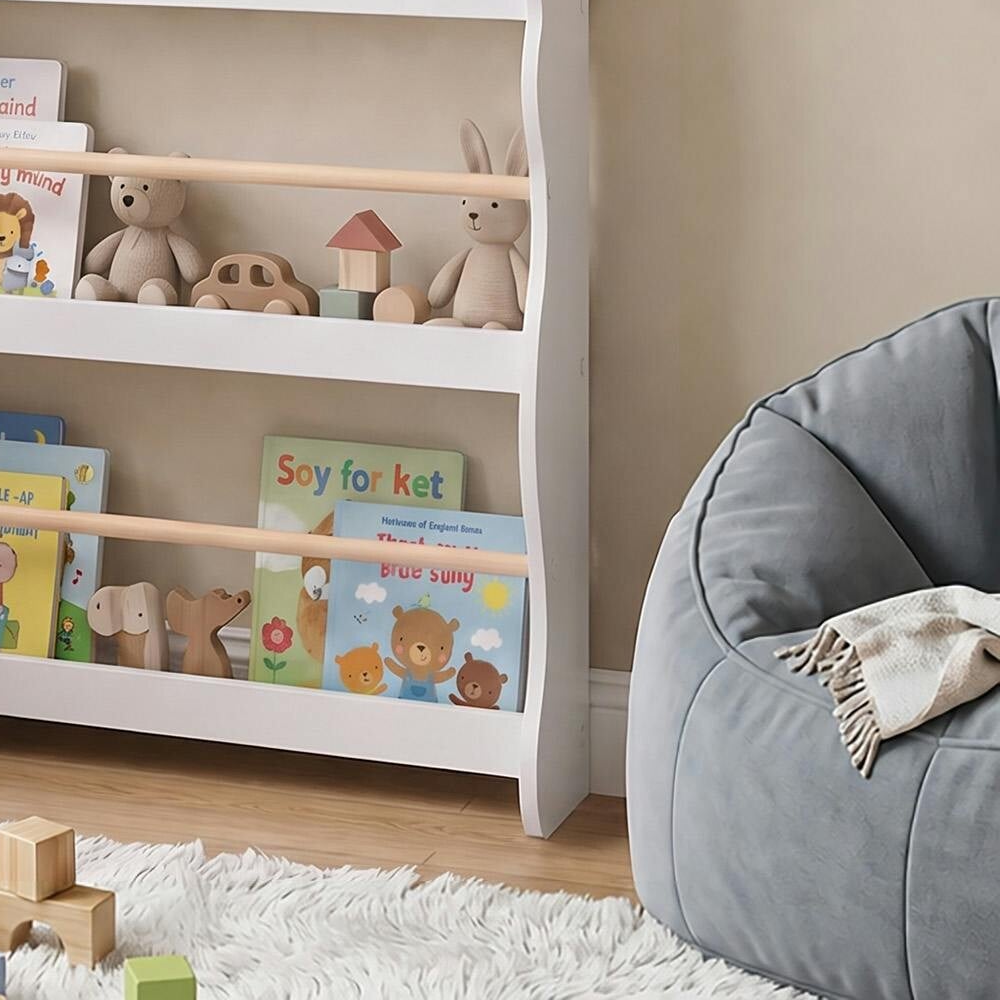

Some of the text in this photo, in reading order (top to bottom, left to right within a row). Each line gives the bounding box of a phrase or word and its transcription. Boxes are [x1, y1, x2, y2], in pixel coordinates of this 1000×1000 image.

[275, 453, 445, 500] Soy for ket
